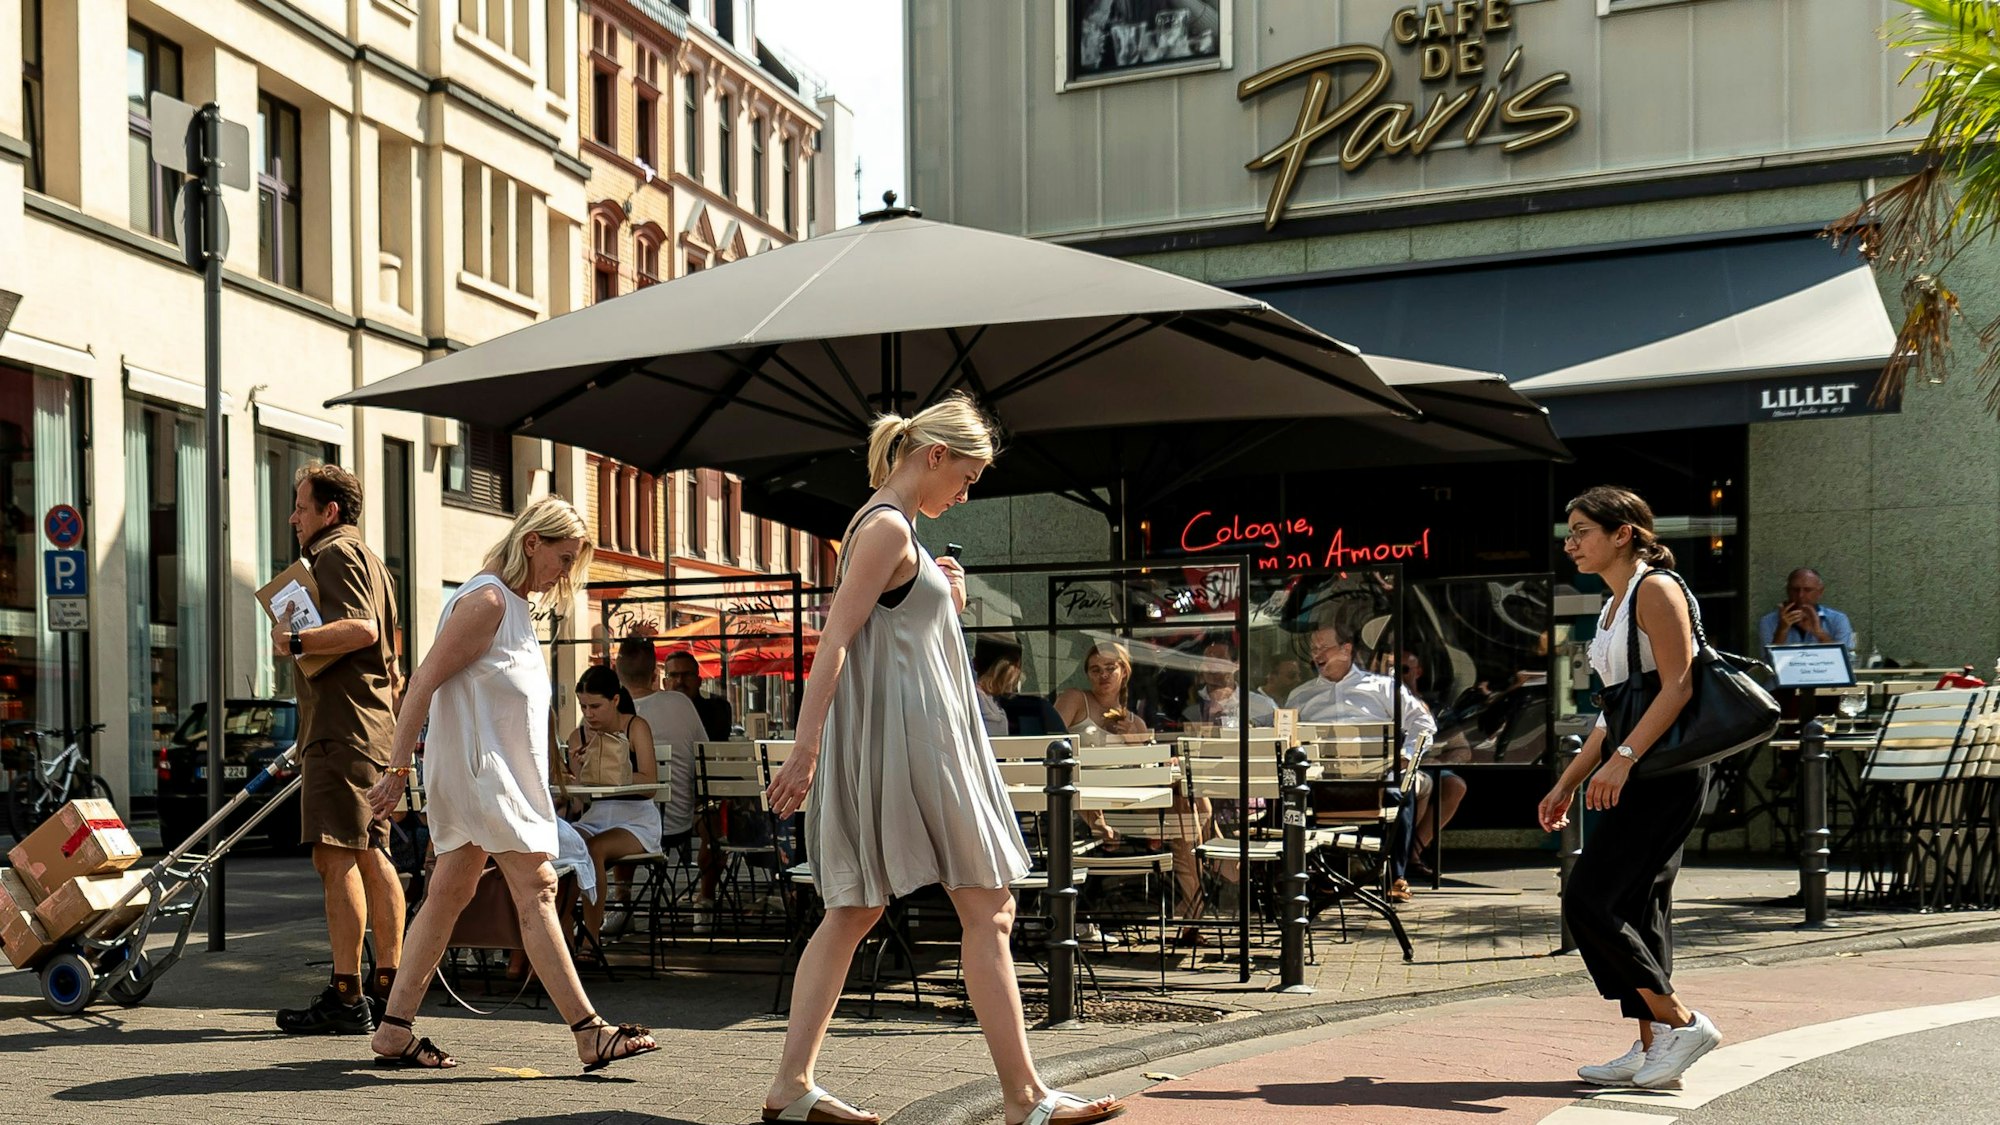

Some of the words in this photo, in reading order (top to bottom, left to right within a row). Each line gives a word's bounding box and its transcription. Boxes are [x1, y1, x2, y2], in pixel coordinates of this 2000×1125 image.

[1420, 40, 1485, 81] DE
[1237, 43, 1580, 231] Paris
[1761, 382, 1859, 409] LILLET
[54, 556, 77, 590] P
[1063, 588, 1115, 618] Paris
[614, 610, 659, 636] Paris
